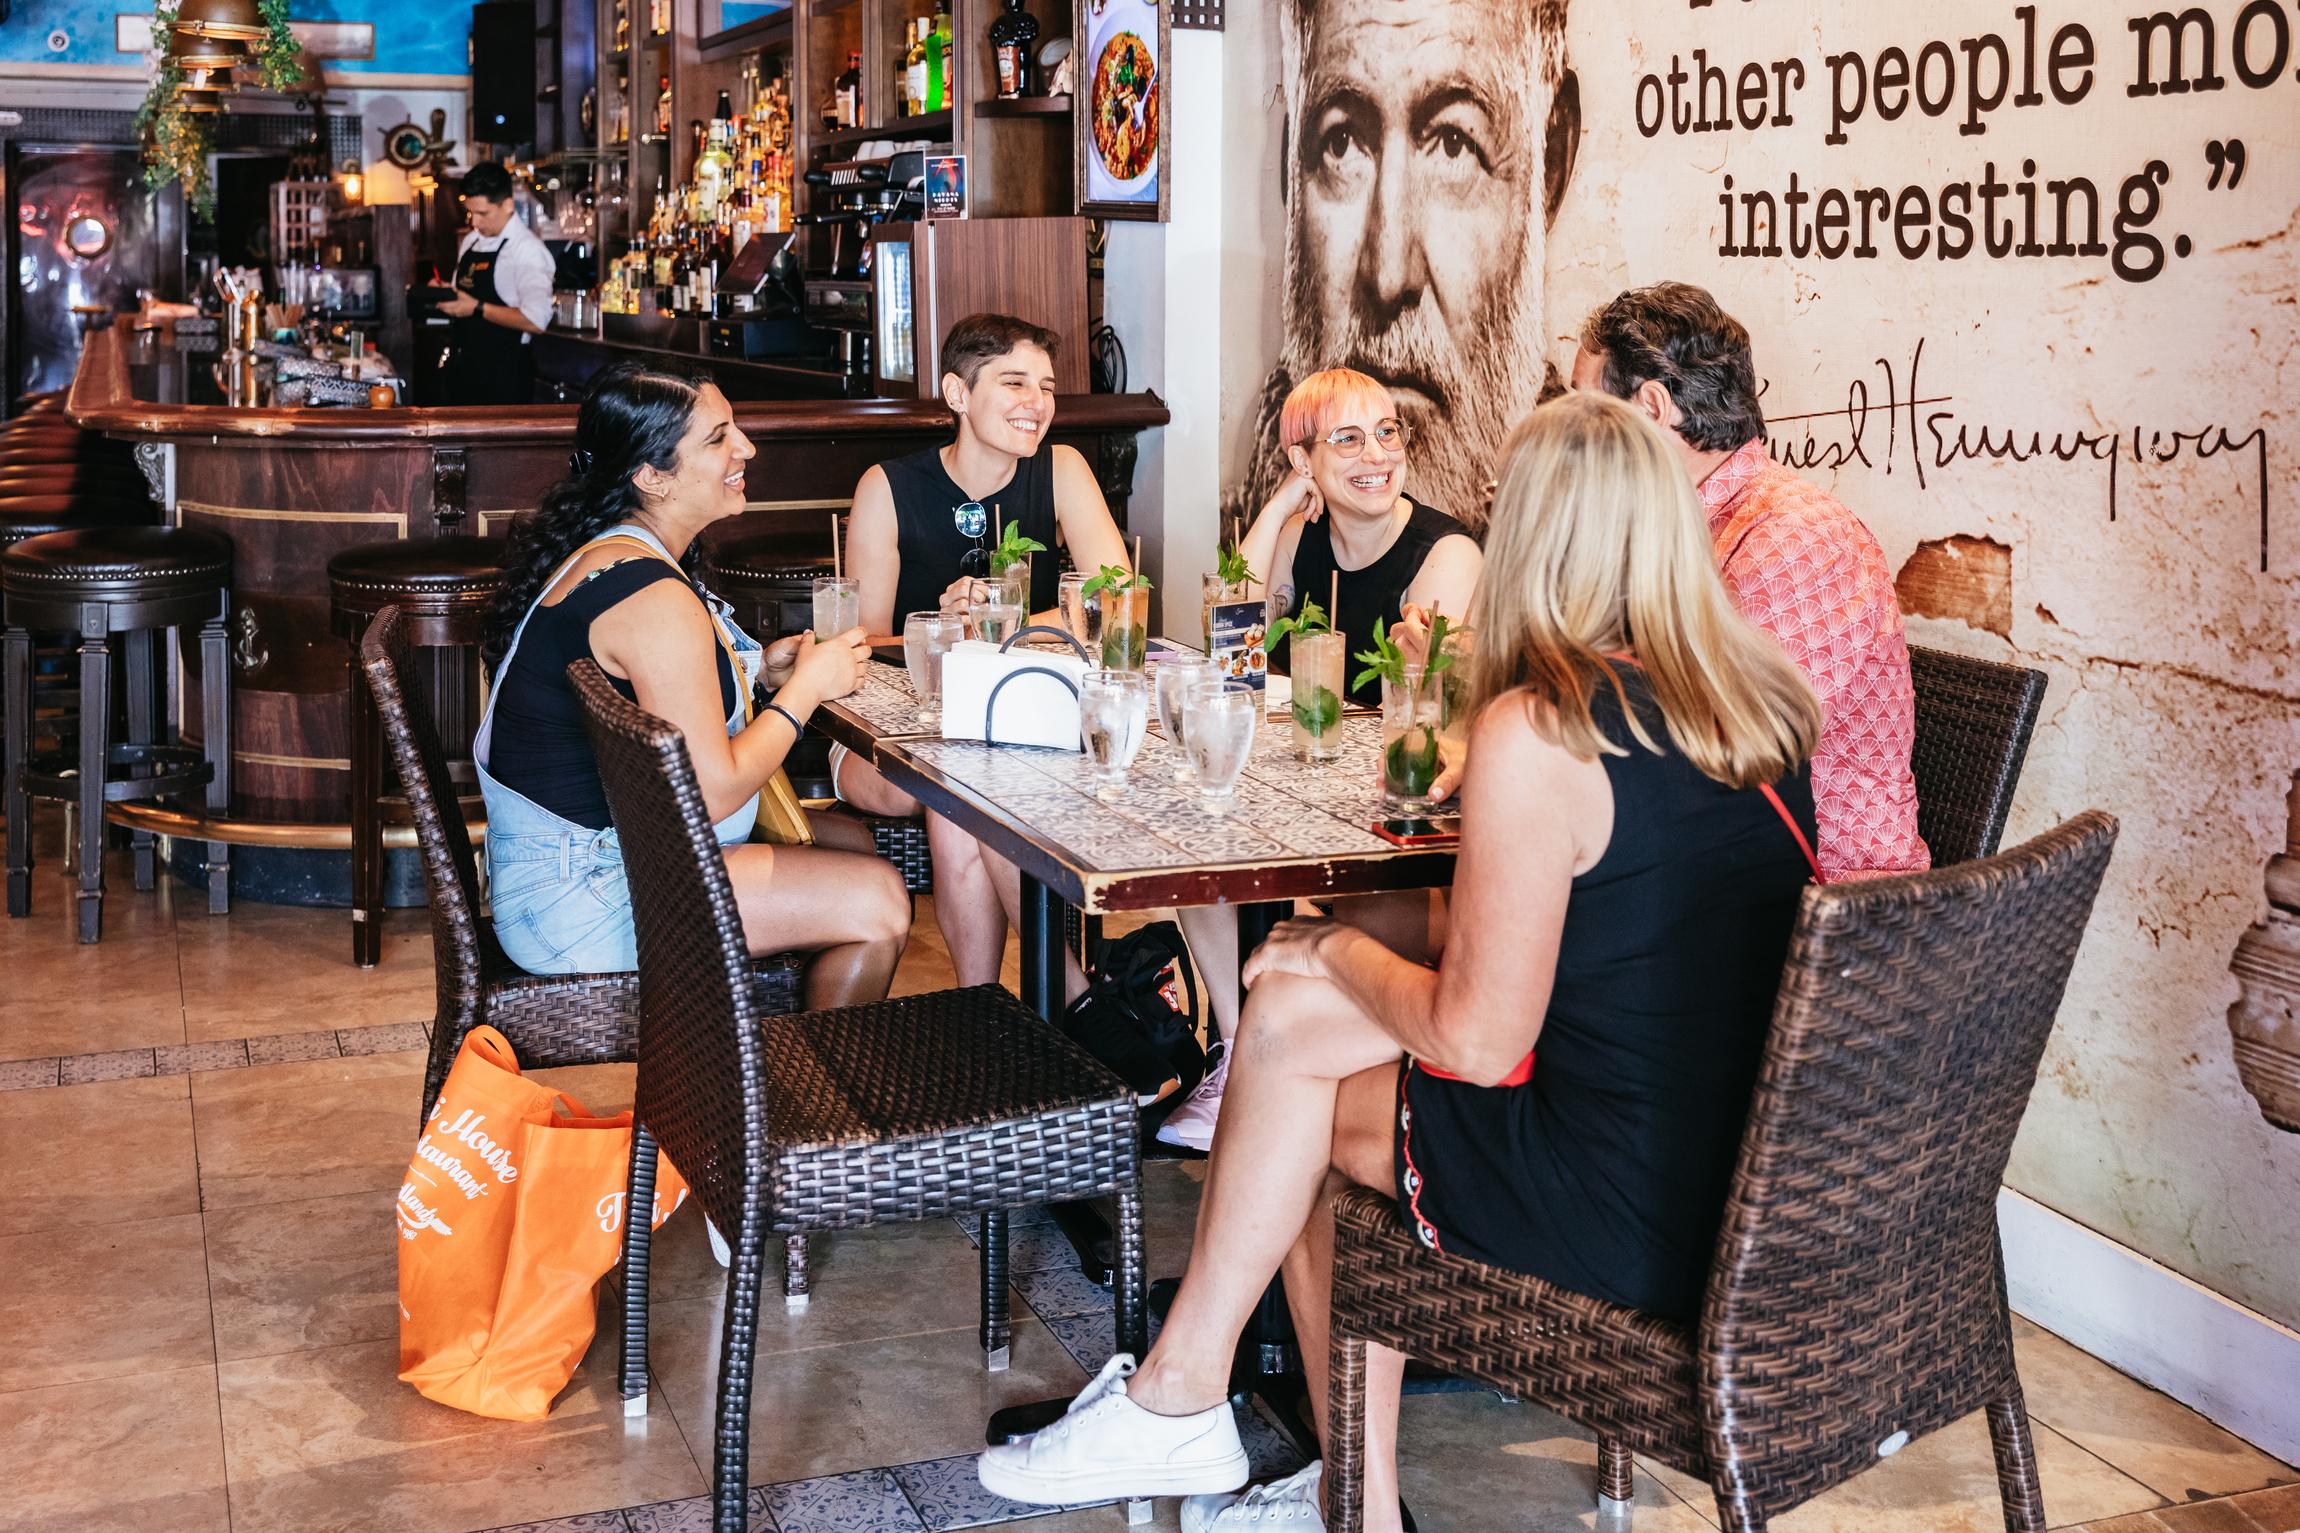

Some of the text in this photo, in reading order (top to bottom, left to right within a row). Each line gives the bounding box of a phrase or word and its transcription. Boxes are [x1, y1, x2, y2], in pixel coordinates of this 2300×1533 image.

[1635, 0, 2300, 146] other people mo
[1875, 337, 2269, 574] Hemingway
[415, 1133, 489, 1200] taurant
[437, 1108, 518, 1184] House
